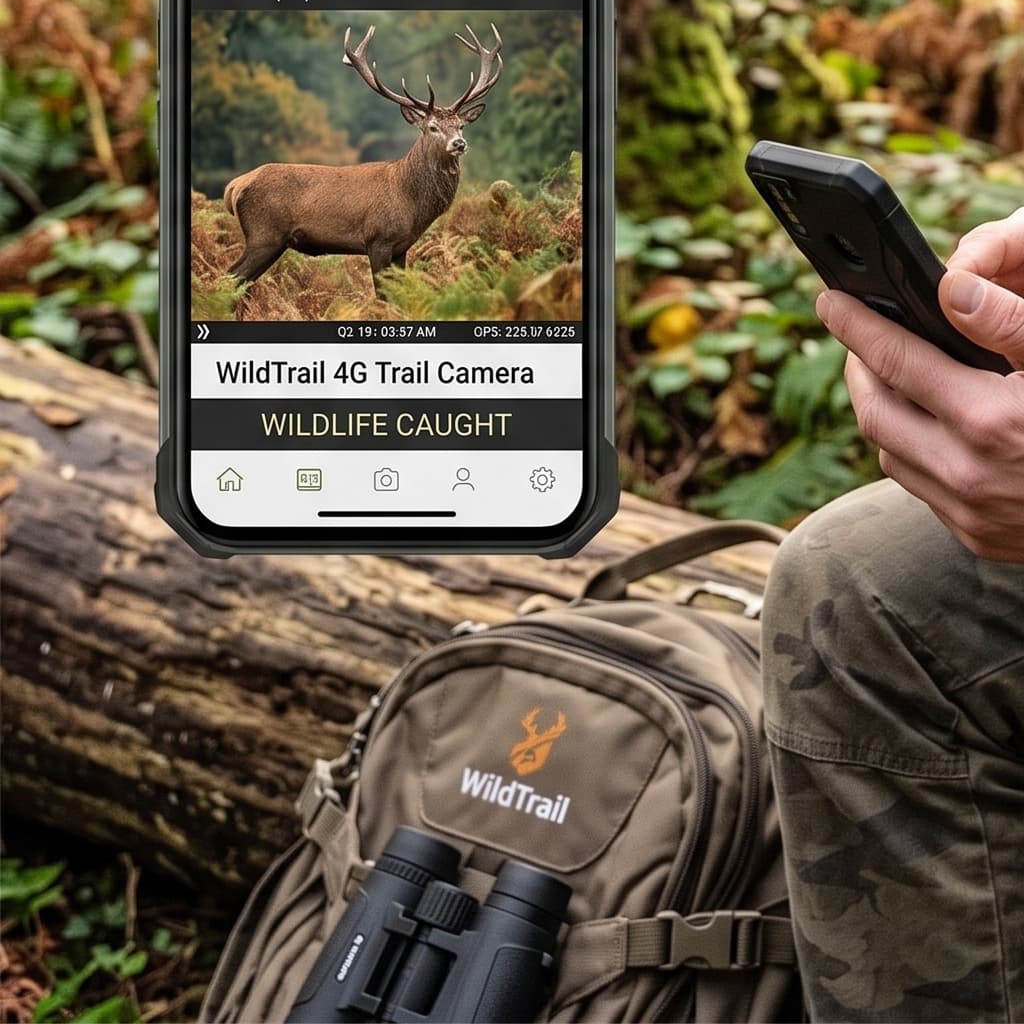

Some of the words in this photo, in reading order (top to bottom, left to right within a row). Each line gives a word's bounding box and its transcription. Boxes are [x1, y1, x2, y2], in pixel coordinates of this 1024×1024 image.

[381, 326, 414, 338] 03:57
[415, 326, 436, 337] AM
[216, 360, 325, 384] WildTrail
[333, 360, 367, 384] 4G
[374, 360, 429, 384] Trail
[437, 360, 535, 384] Camera
[261, 413, 388, 436] WILDLIFE
[396, 413, 513, 436] CAUGHT
[460, 767, 571, 824] WildTrail
